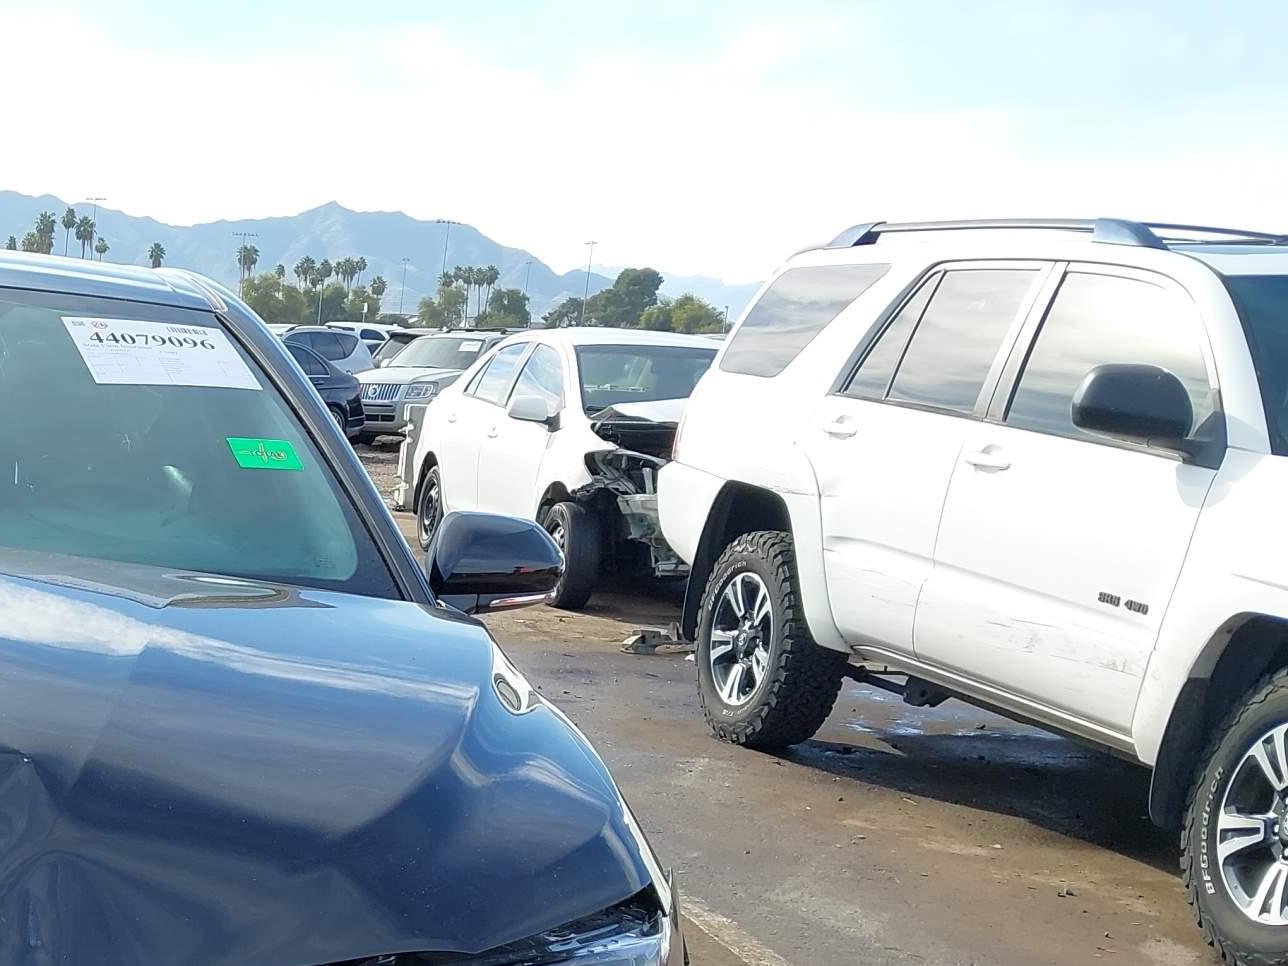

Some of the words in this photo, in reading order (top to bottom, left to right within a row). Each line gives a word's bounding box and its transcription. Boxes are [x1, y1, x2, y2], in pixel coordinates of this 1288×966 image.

[89, 331, 215, 350] 44079096
[1124, 599, 1149, 615] 4WD
[1199, 766, 1224, 895] BFGoodrich
